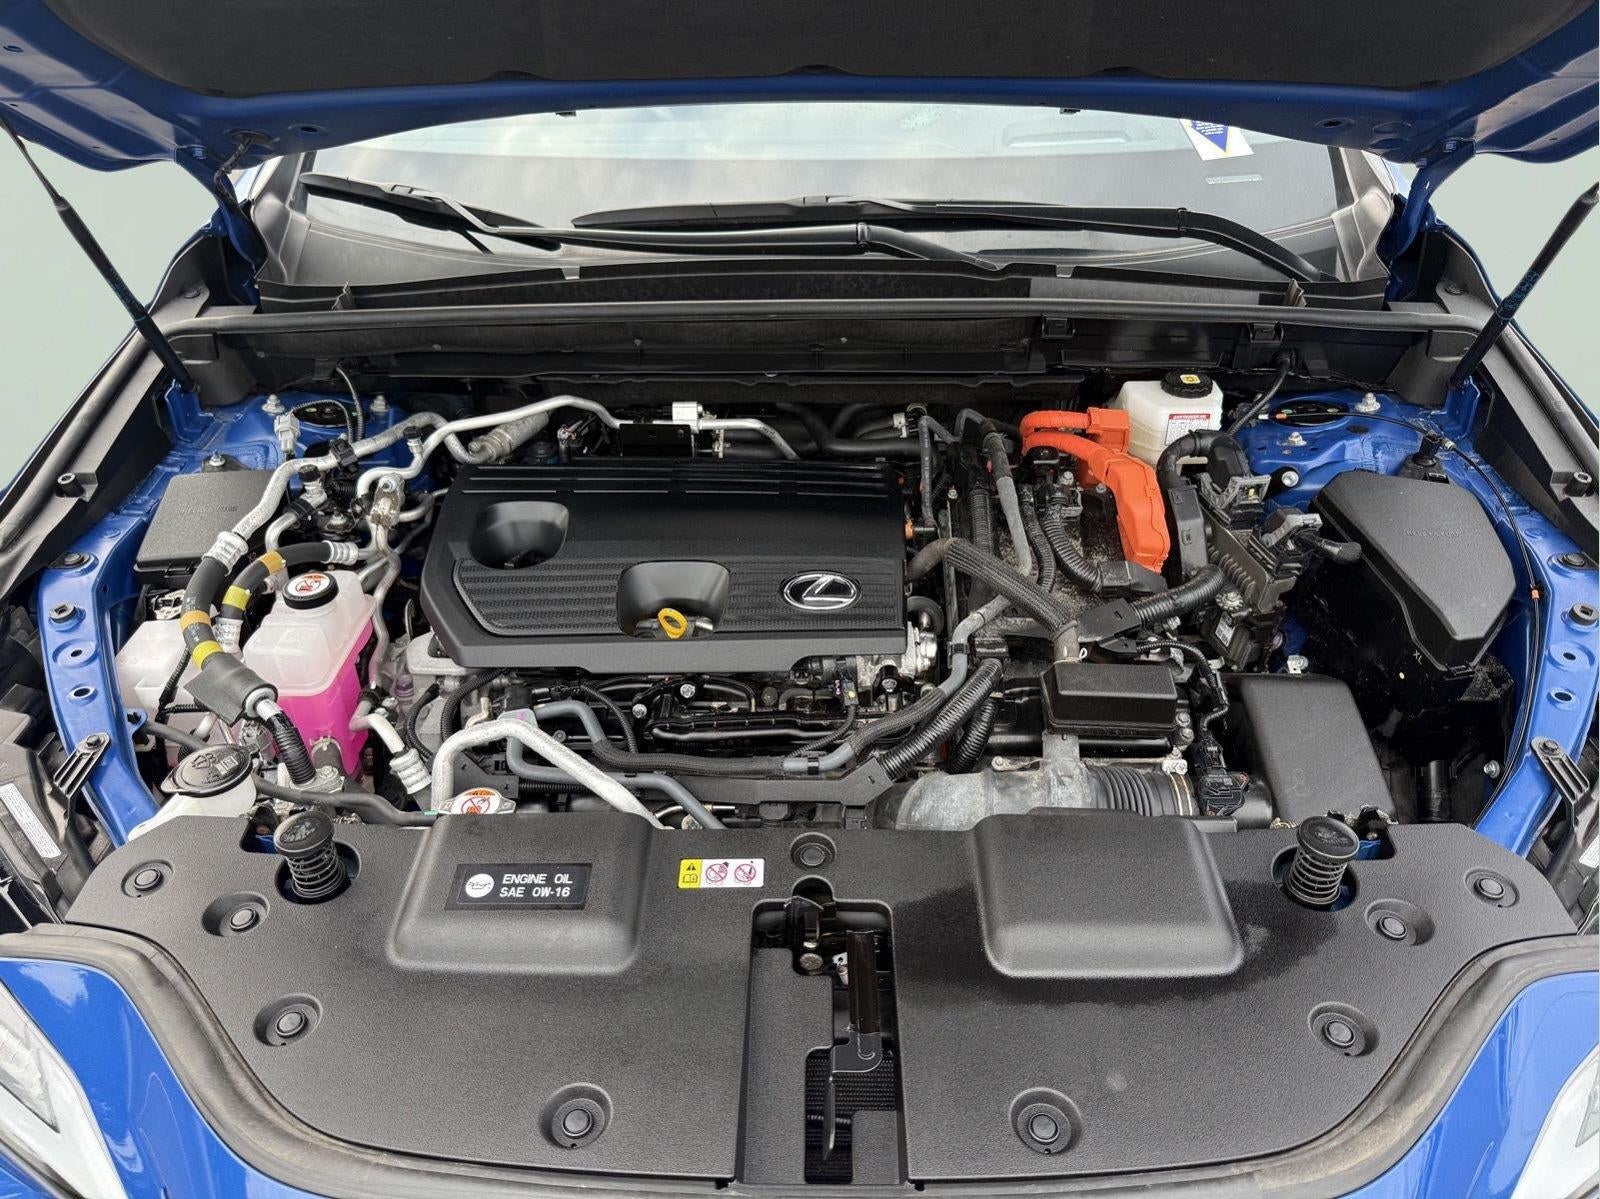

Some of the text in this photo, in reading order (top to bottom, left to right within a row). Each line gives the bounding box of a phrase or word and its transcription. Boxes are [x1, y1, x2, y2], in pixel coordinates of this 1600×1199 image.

[502, 873, 573, 884] ENGINE OIL
[499, 886, 571, 898] SAE 0W-16
